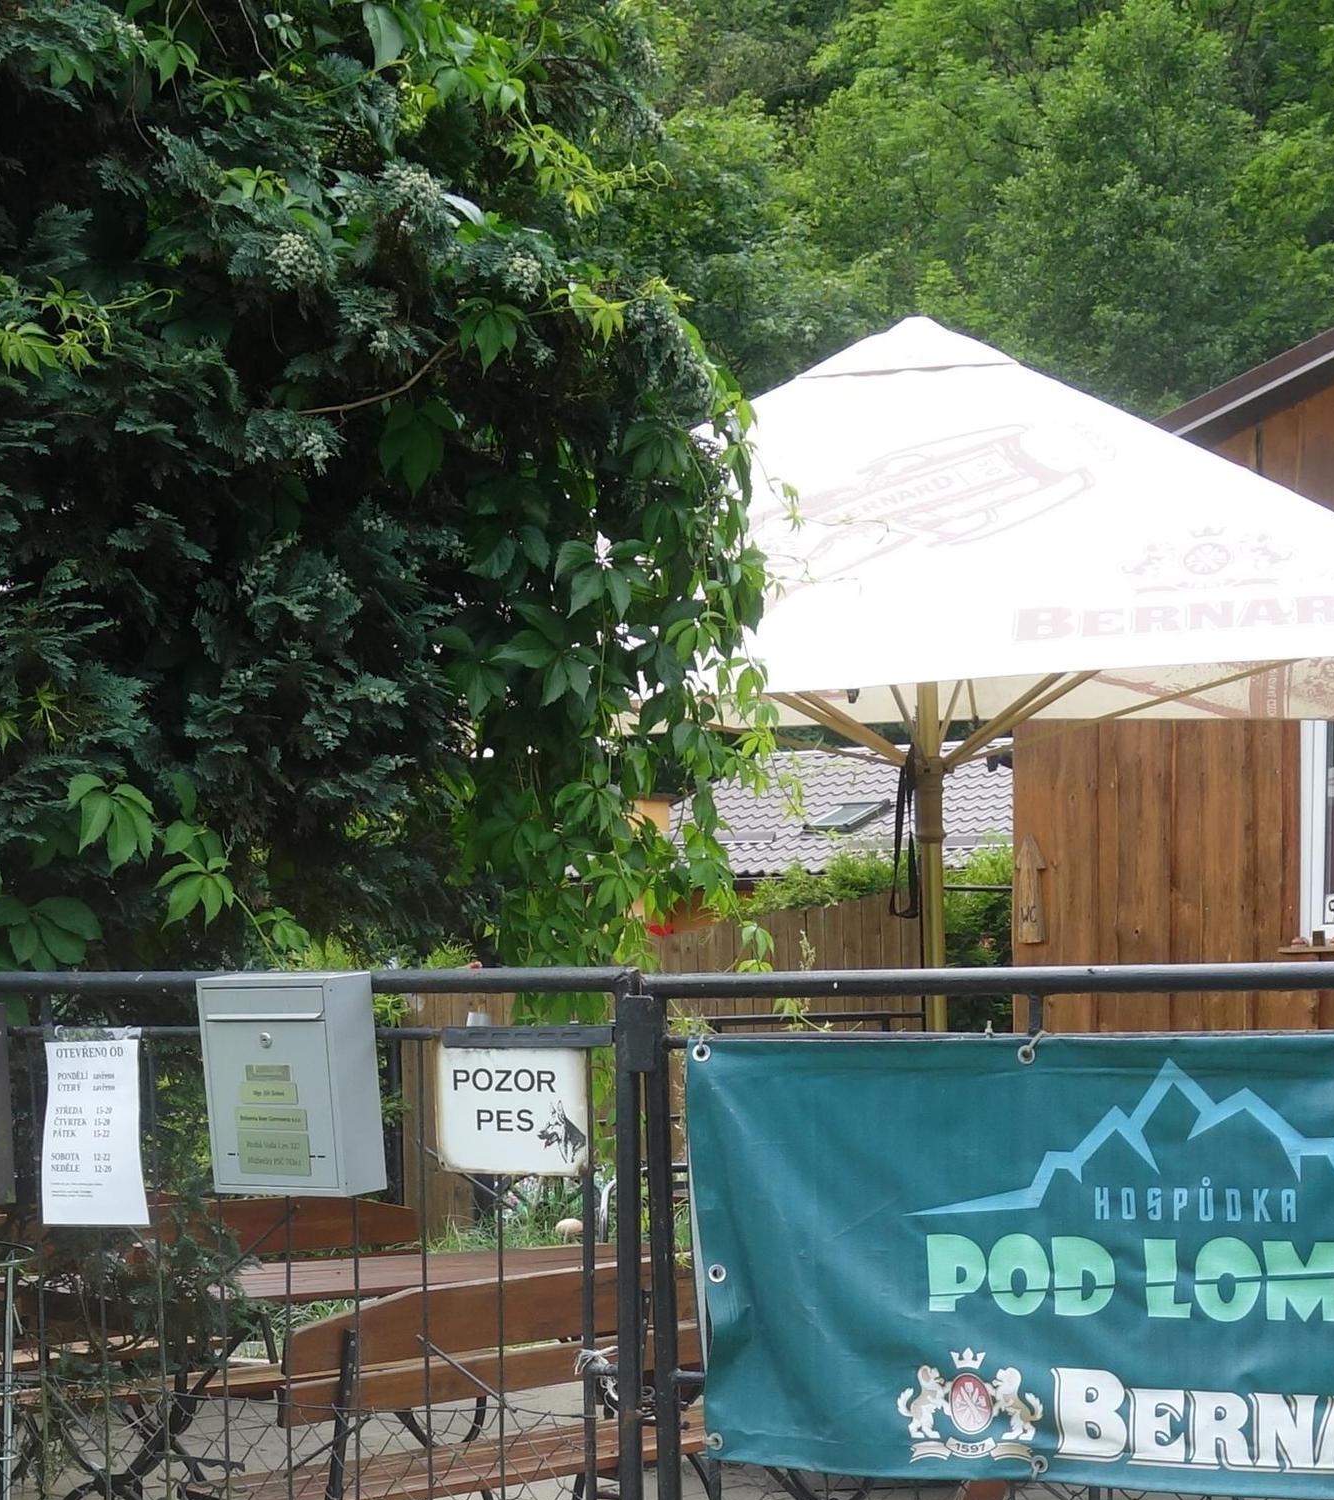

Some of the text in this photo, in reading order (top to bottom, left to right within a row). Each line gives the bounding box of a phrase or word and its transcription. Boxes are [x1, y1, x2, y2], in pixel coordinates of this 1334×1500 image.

[1020, 905, 1037, 923] WC
[56, 1045, 124, 1058] OTEVŘENO OD
[57, 1070, 88, 1080] PONDĚLÍ
[453, 1068, 556, 1093] POZOR
[57, 1082, 80, 1092] ÚTERÝ
[55, 1105, 83, 1115] STŘEDA
[54, 1117, 87, 1126] ČTVRTEK
[476, 1109, 534, 1132] PES
[53, 1128, 76, 1138] PÁTEK
[51, 1152, 80, 1161] SOBOTA
[51, 1163, 80, 1173] NEDĚLE
[1093, 1174, 1298, 1224] HOSPŮDKA
[927, 1232, 1115, 1317] POD
[955, 1442, 986, 1454] 1597
